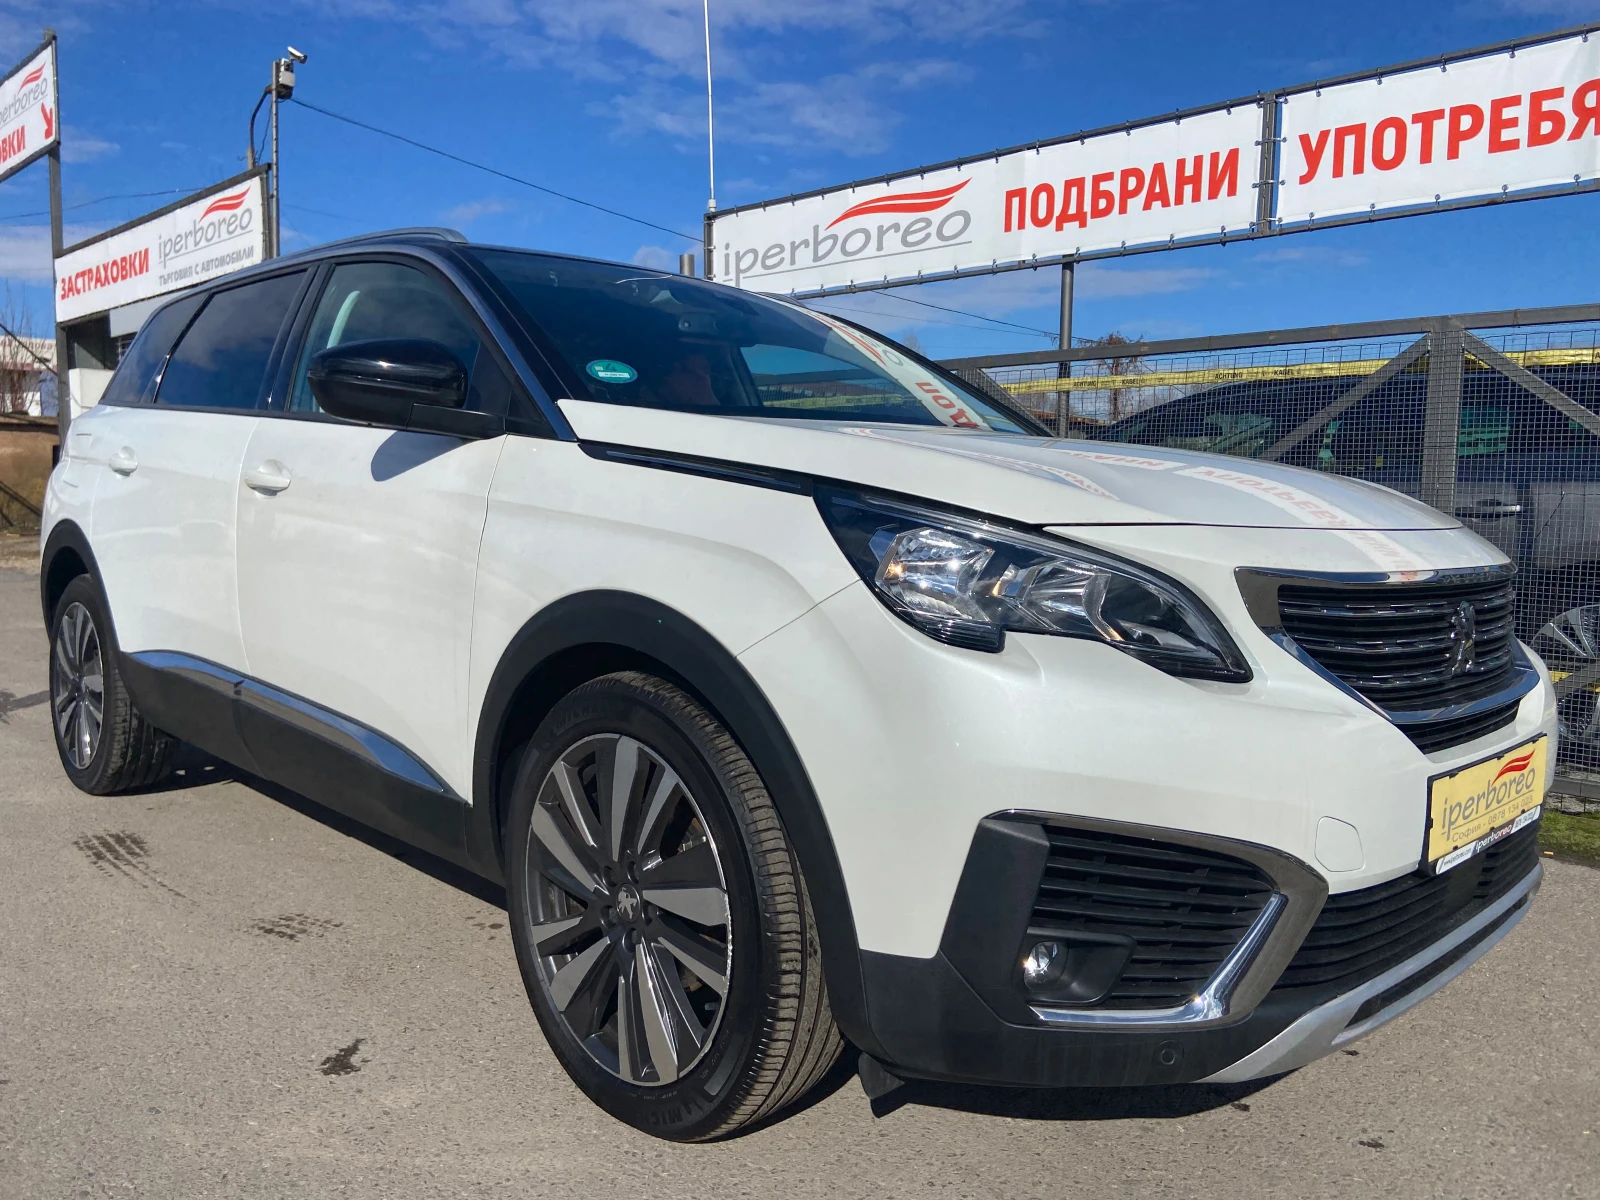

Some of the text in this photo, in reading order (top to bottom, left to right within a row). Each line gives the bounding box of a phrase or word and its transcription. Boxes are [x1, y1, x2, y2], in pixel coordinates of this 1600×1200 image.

[1298, 78, 1600, 185] УПОТРЕБЯ
[1004, 147, 1240, 232] ПОДБРАНИ
[158, 207, 252, 269] iperboreo
[159, 264, 194, 287] ТЪРГОВИЯ
[200, 245, 254, 273] АВТОМОБИЛИ
[723, 209, 972, 287] iperboreo
[61, 248, 150, 300] ЗАСТРАХОВКИ
[1442, 768, 1536, 841] iperboreo
[1452, 823, 1481, 843] София
[1487, 811, 1506, 825] 0878
[1508, 803, 1519, 815] 134
[1475, 824, 1513, 853] iperboreo
